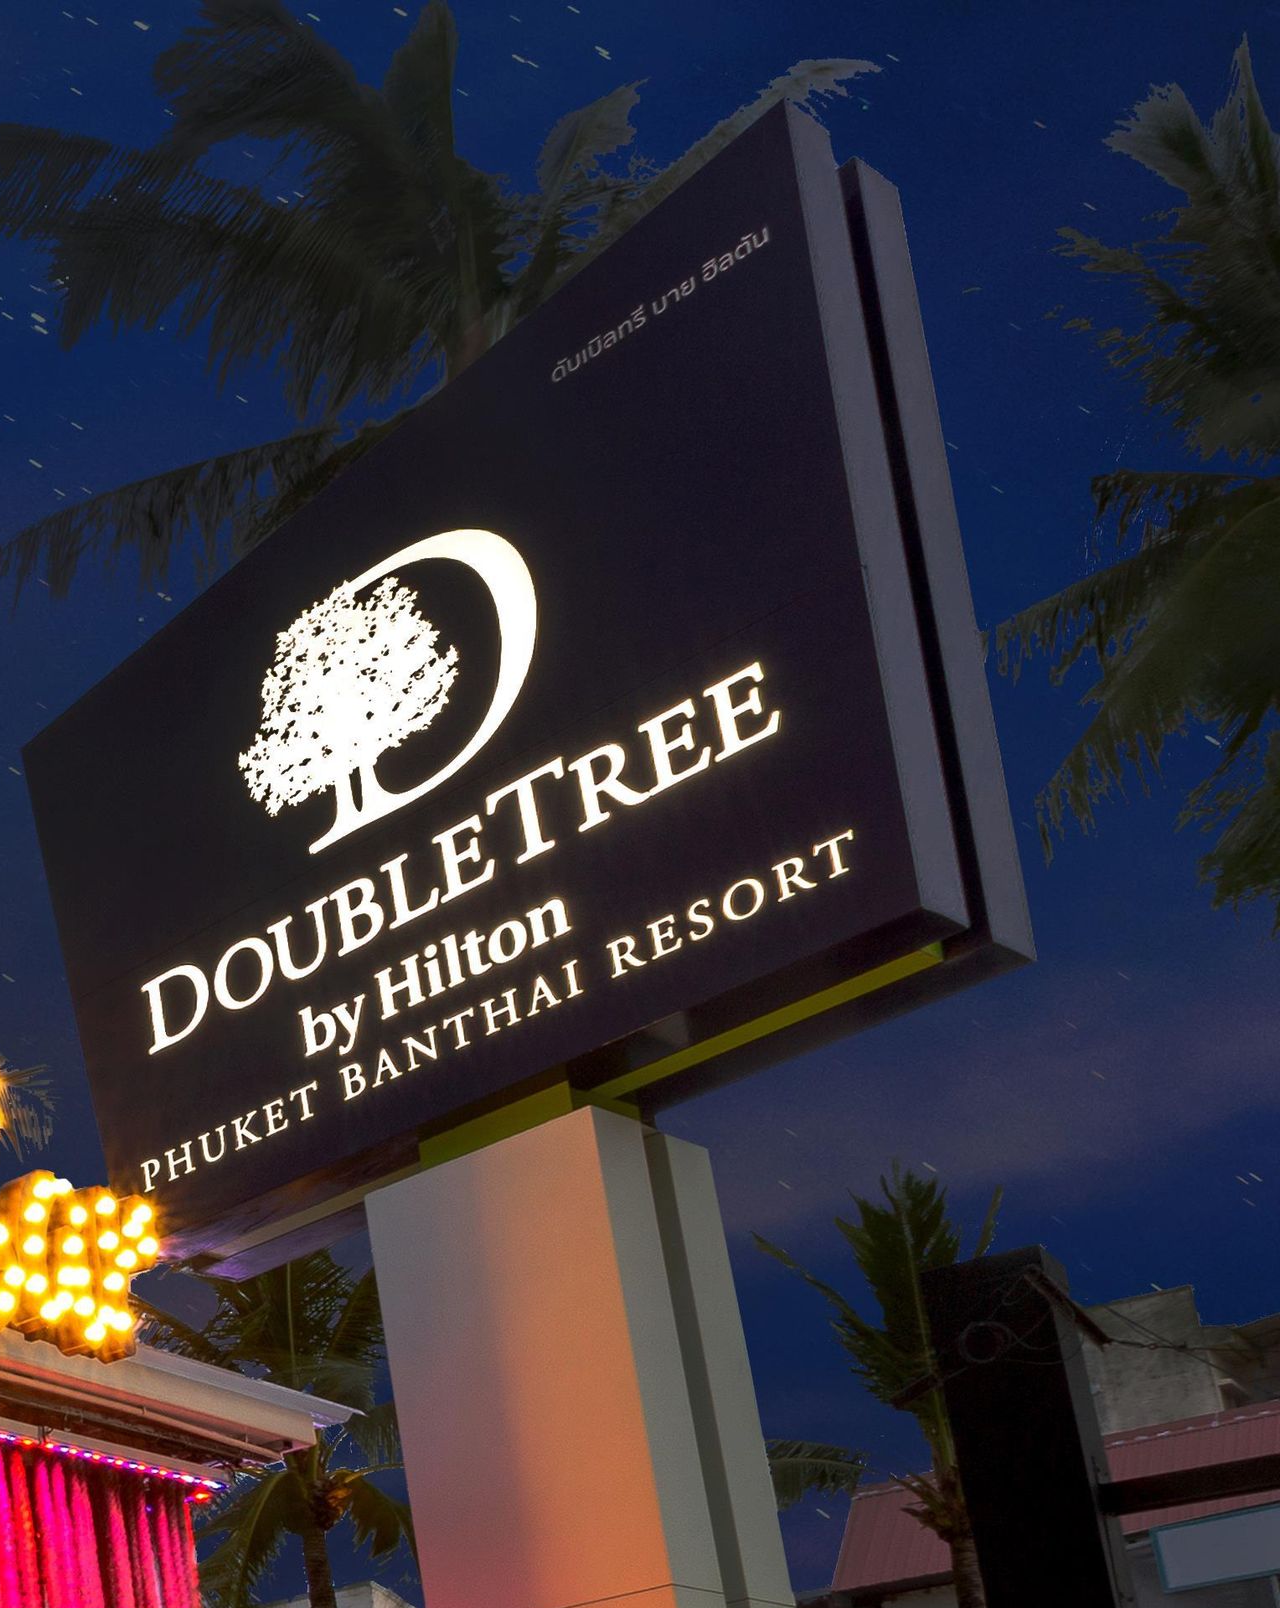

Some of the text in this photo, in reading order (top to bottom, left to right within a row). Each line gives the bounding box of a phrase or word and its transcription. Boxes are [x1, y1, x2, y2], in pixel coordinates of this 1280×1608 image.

[652, 276, 696, 315] บาย
[141, 830, 854, 1193] PHUKET BANTHAI RESORT
[298, 899, 572, 1057] by Hilton
